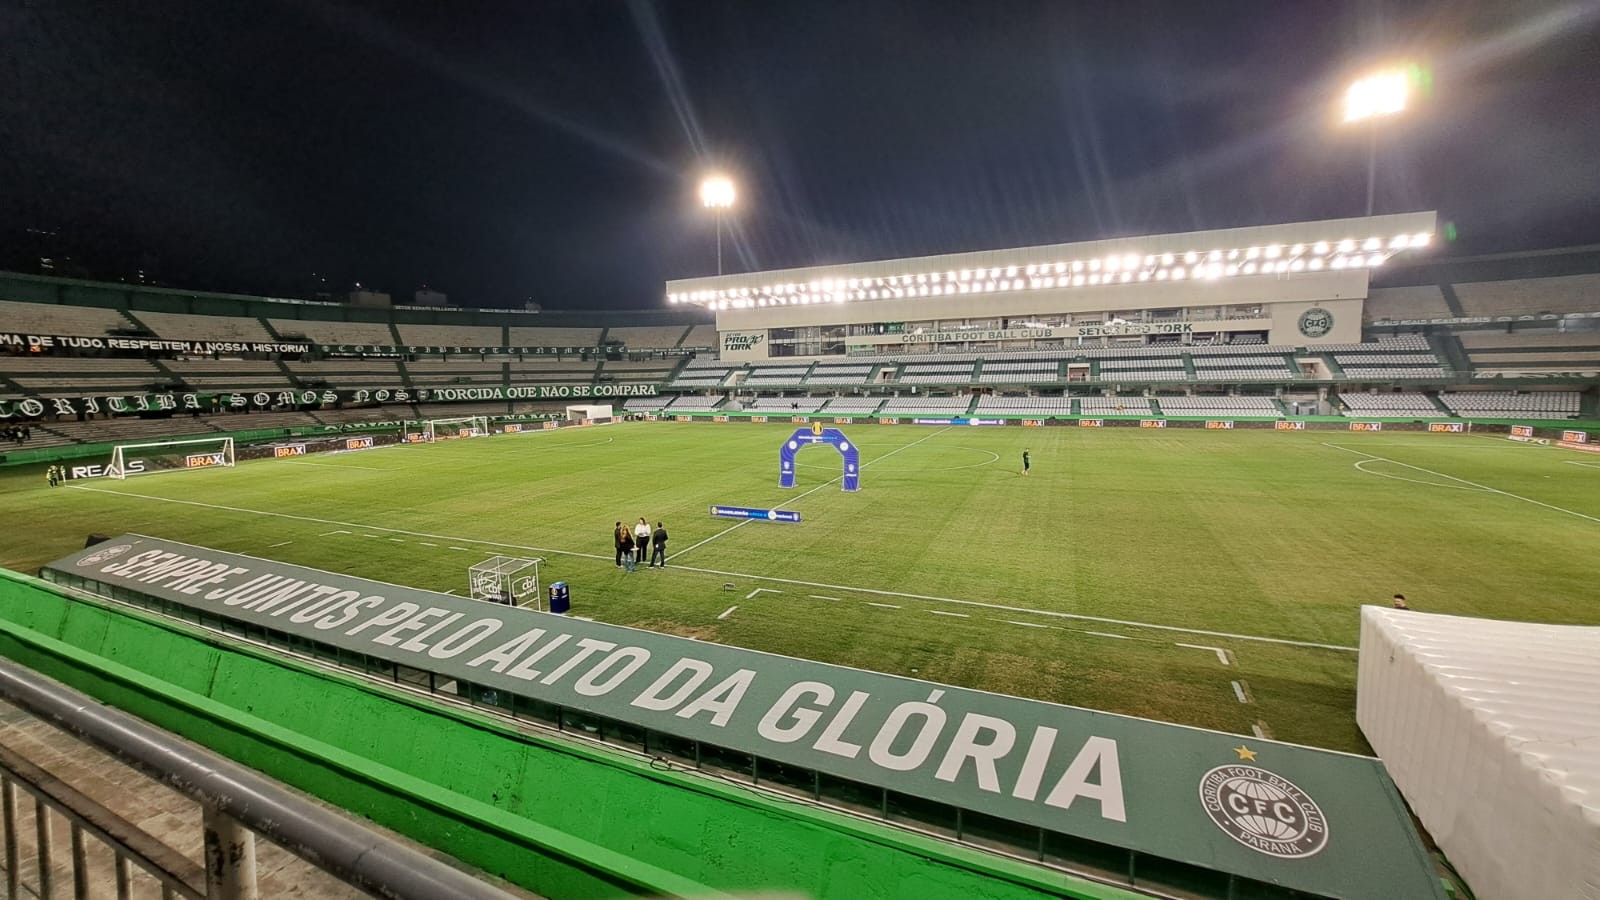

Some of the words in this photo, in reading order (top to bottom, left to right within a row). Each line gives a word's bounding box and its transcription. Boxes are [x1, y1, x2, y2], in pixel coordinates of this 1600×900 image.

[1155, 323, 1192, 333] TORK
[902, 333, 951, 343] CORITIBA
[955, 332, 984, 341] FOOT
[988, 330, 1017, 340] BALL
[1020, 328, 1053, 338] CLUB
[28, 336, 54, 346] DE
[56, 337, 106, 349] TUDO,
[108, 339, 190, 351] RESPEITEM
[194, 342, 202, 351] A
[205, 342, 249, 352] NOSSA
[230, 390, 338, 407] SOMOS
[434, 387, 504, 400] TORCIDA
[507, 386, 537, 399] QUE
[540, 384, 569, 398] NÃO
[573, 386, 590, 397] SE
[593, 384, 657, 397] COMPARA
[1278, 422, 1302, 430] BRAX
[1352, 423, 1378, 431] BRAX
[1432, 424, 1460, 432] BRAX
[350, 439, 371, 449] BRAX
[278, 446, 304, 457] BRAX
[190, 455, 221, 467] BRAX
[522, 576, 536, 590] cbf
[100, 549, 250, 595] SEMPRE
[204, 573, 385, 630] JUNTOS
[344, 602, 503, 659] PELO
[466, 627, 652, 696] ALTO
[630, 656, 757, 728] DA
[757, 681, 1127, 823] GLÓRIA
[1204, 771, 1229, 812] CORITIBA
[1228, 767, 1264, 780] FOOT
[1268, 776, 1302, 800] BALL
[1301, 802, 1323, 833] CLUB
[1228, 793, 1296, 824] CFC
[1239, 831, 1303, 855] PARANÁ
